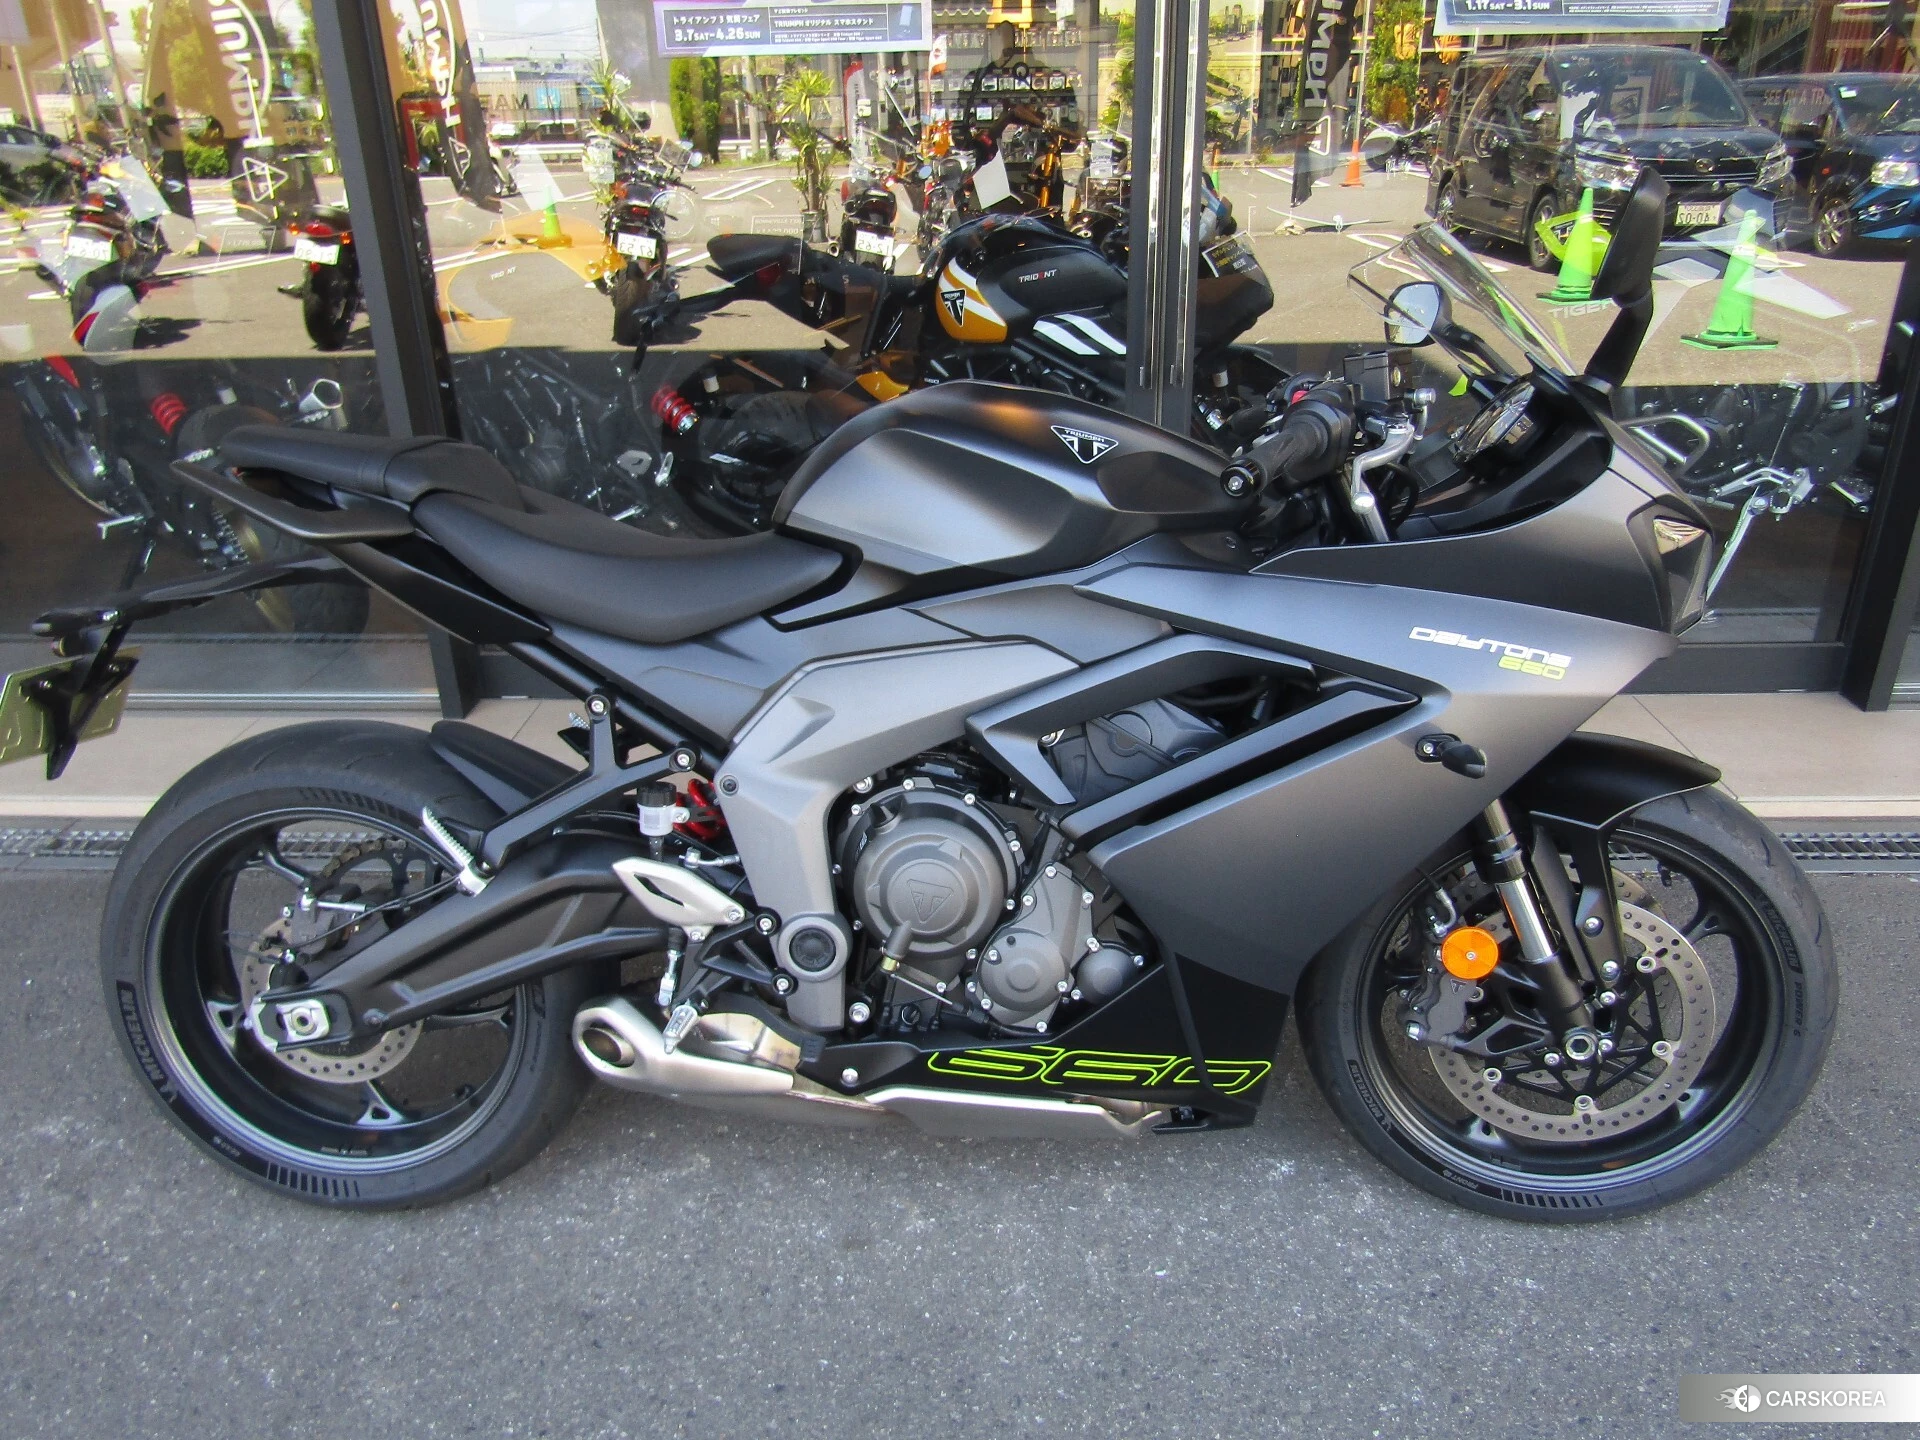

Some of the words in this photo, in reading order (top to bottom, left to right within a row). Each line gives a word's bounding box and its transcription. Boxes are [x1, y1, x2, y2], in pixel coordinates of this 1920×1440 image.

[1064, 429, 1105, 443] TRIUMPH
[1498, 655, 1566, 681] 660
[927, 1045, 1272, 1095] 660
